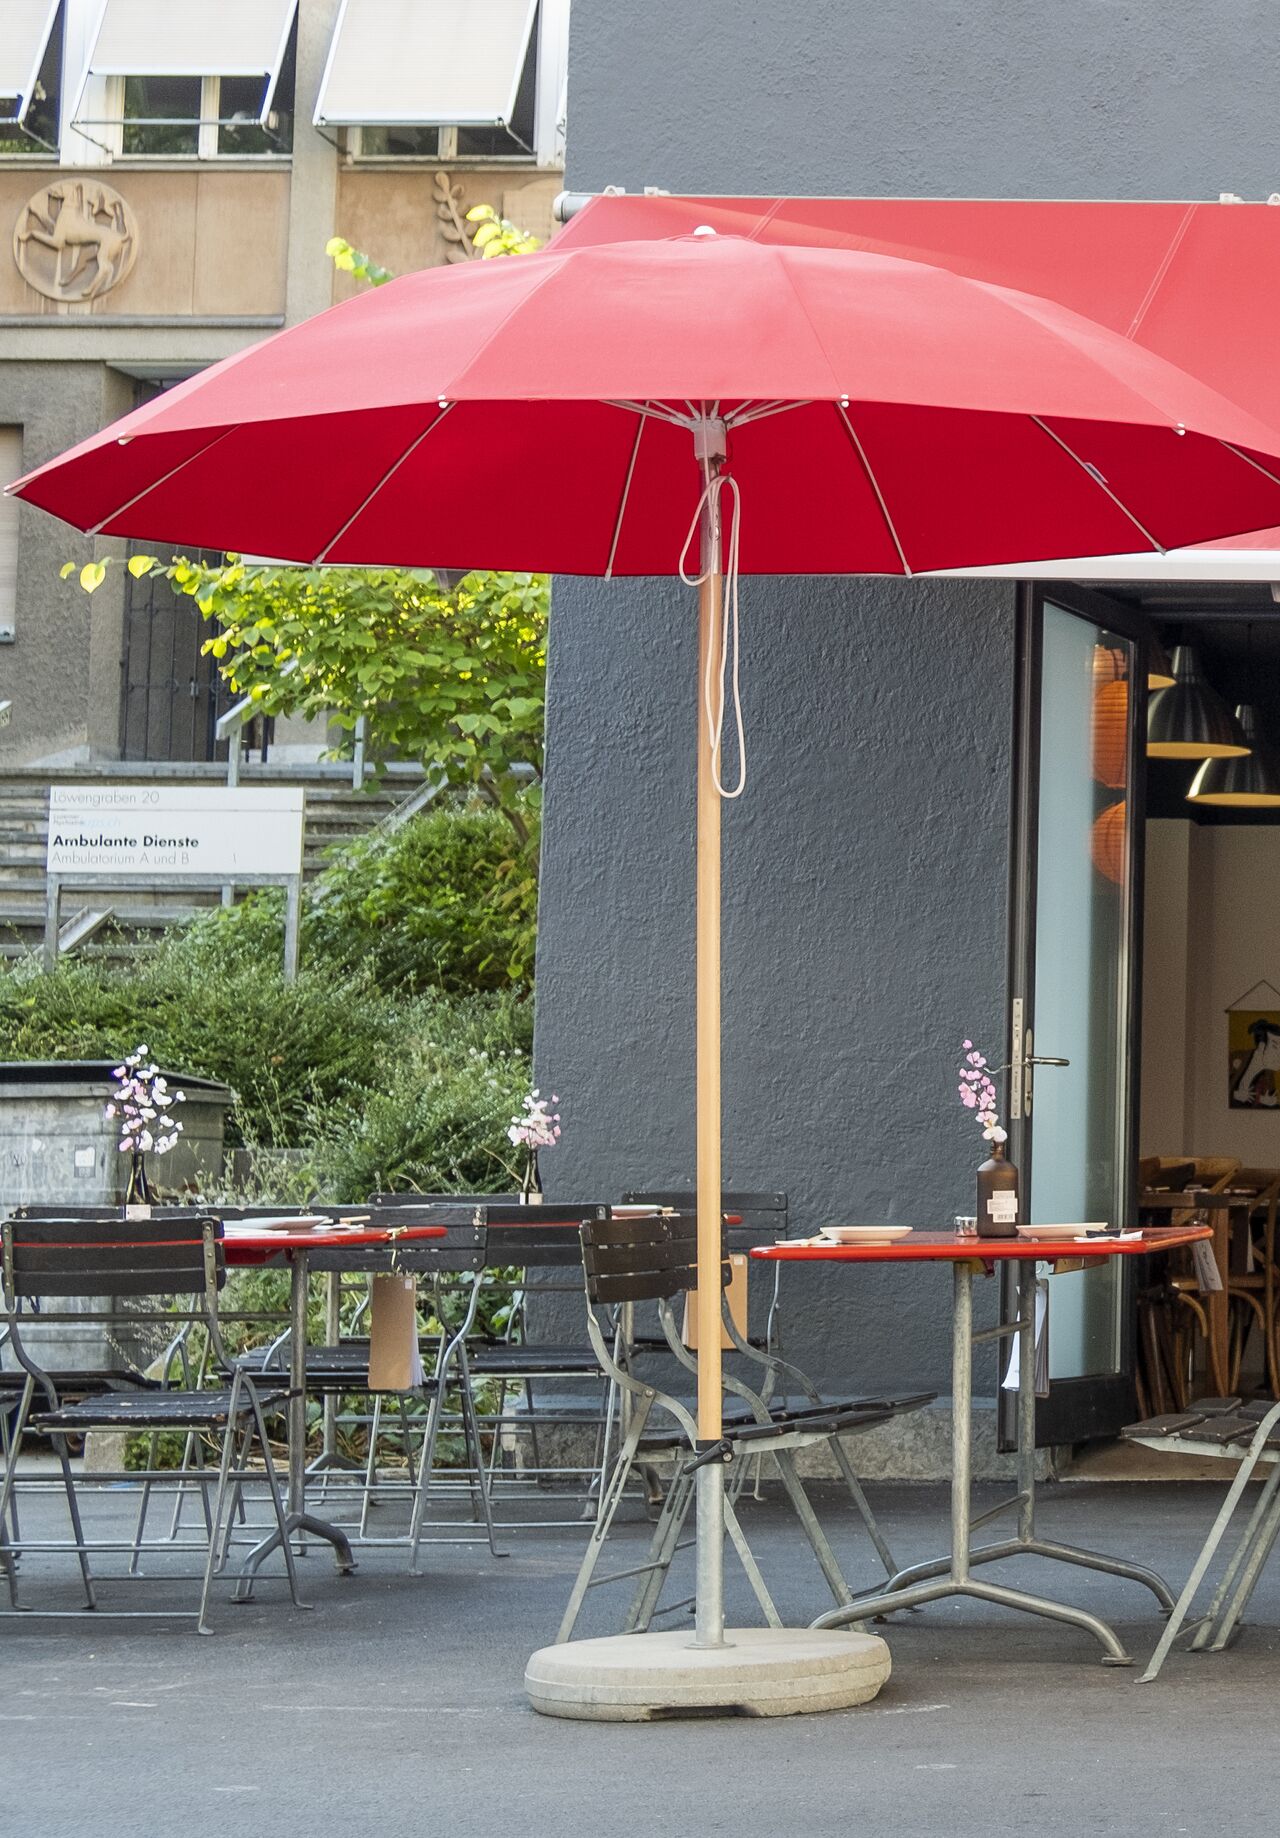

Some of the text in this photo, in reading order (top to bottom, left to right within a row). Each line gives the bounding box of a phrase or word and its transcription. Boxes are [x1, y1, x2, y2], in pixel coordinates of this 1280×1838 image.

[53, 790, 160, 807] Löwengraben 20
[53, 834, 199, 848] Ambulante Dienste
[51, 851, 190, 865] Ambulatorium A und B
